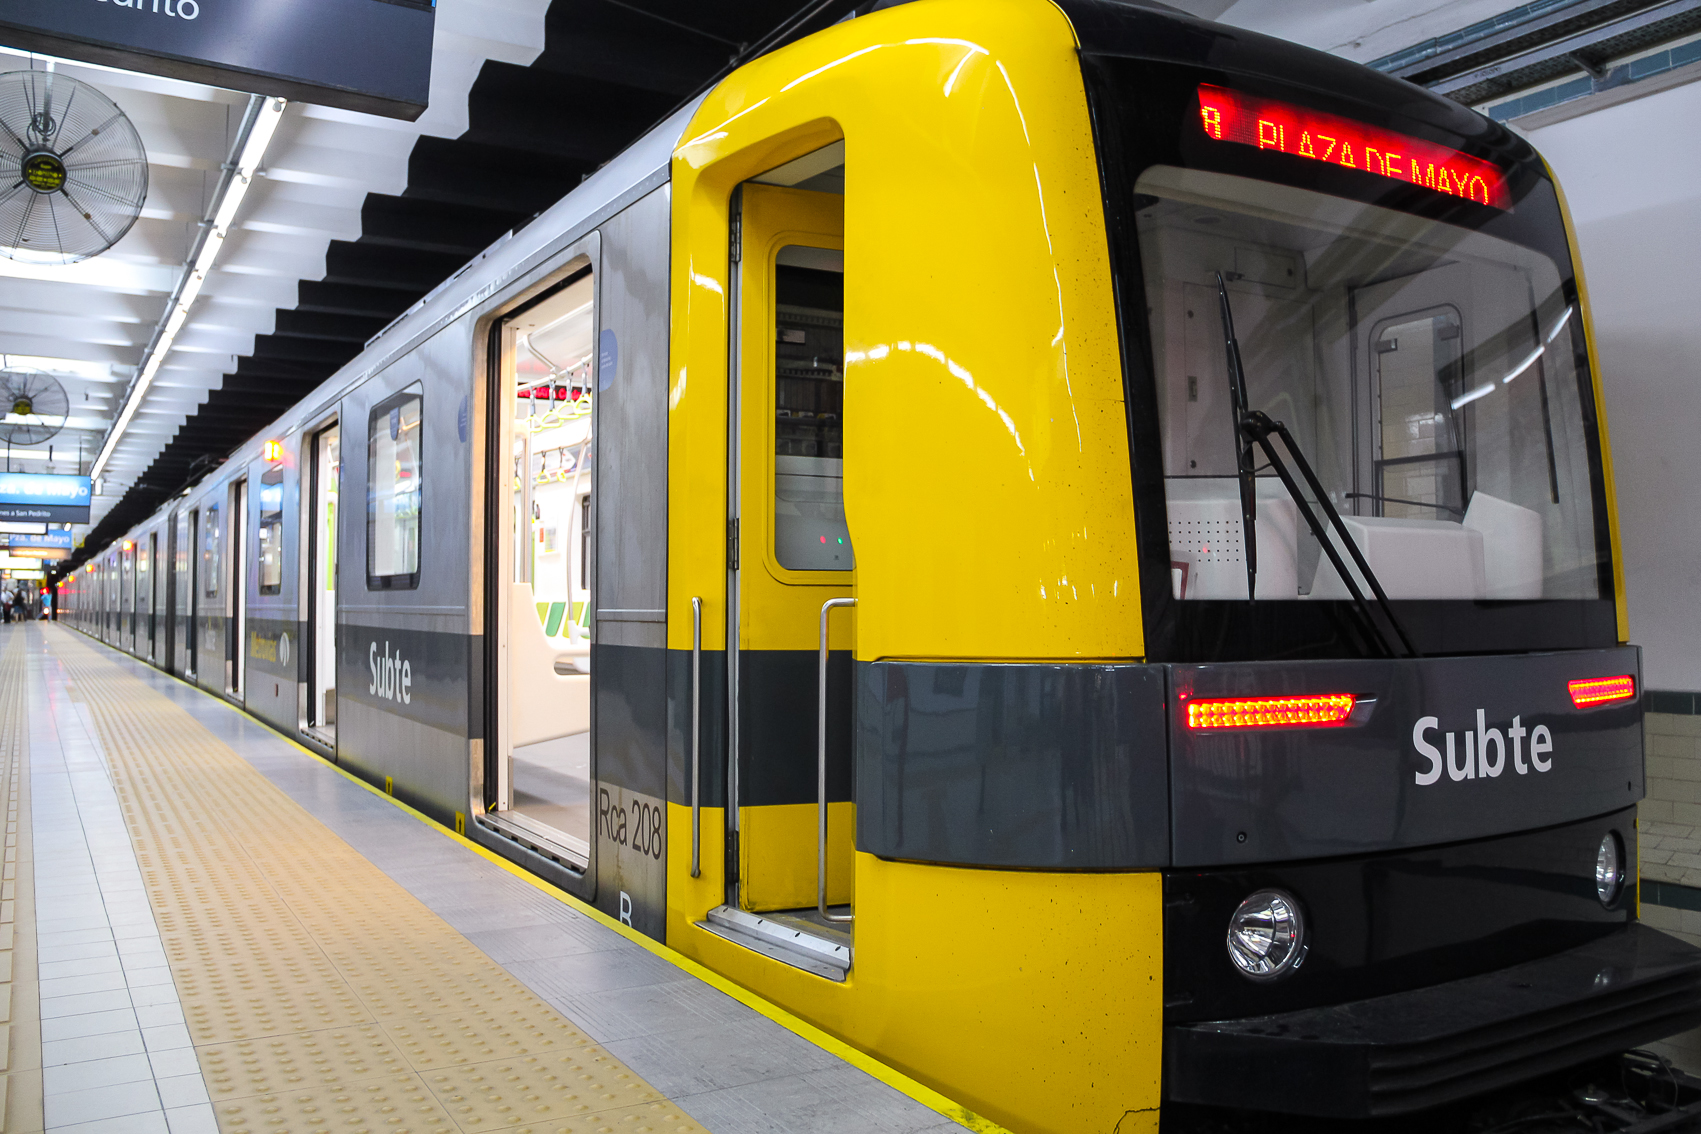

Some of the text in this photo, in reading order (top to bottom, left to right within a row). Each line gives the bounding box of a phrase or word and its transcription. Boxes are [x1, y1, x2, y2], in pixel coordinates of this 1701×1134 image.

[46, 482, 88, 499] Mayo
[369, 640, 412, 705] Subte
[1412, 708, 1553, 786] Subte
[599, 787, 662, 860] Rca 208
